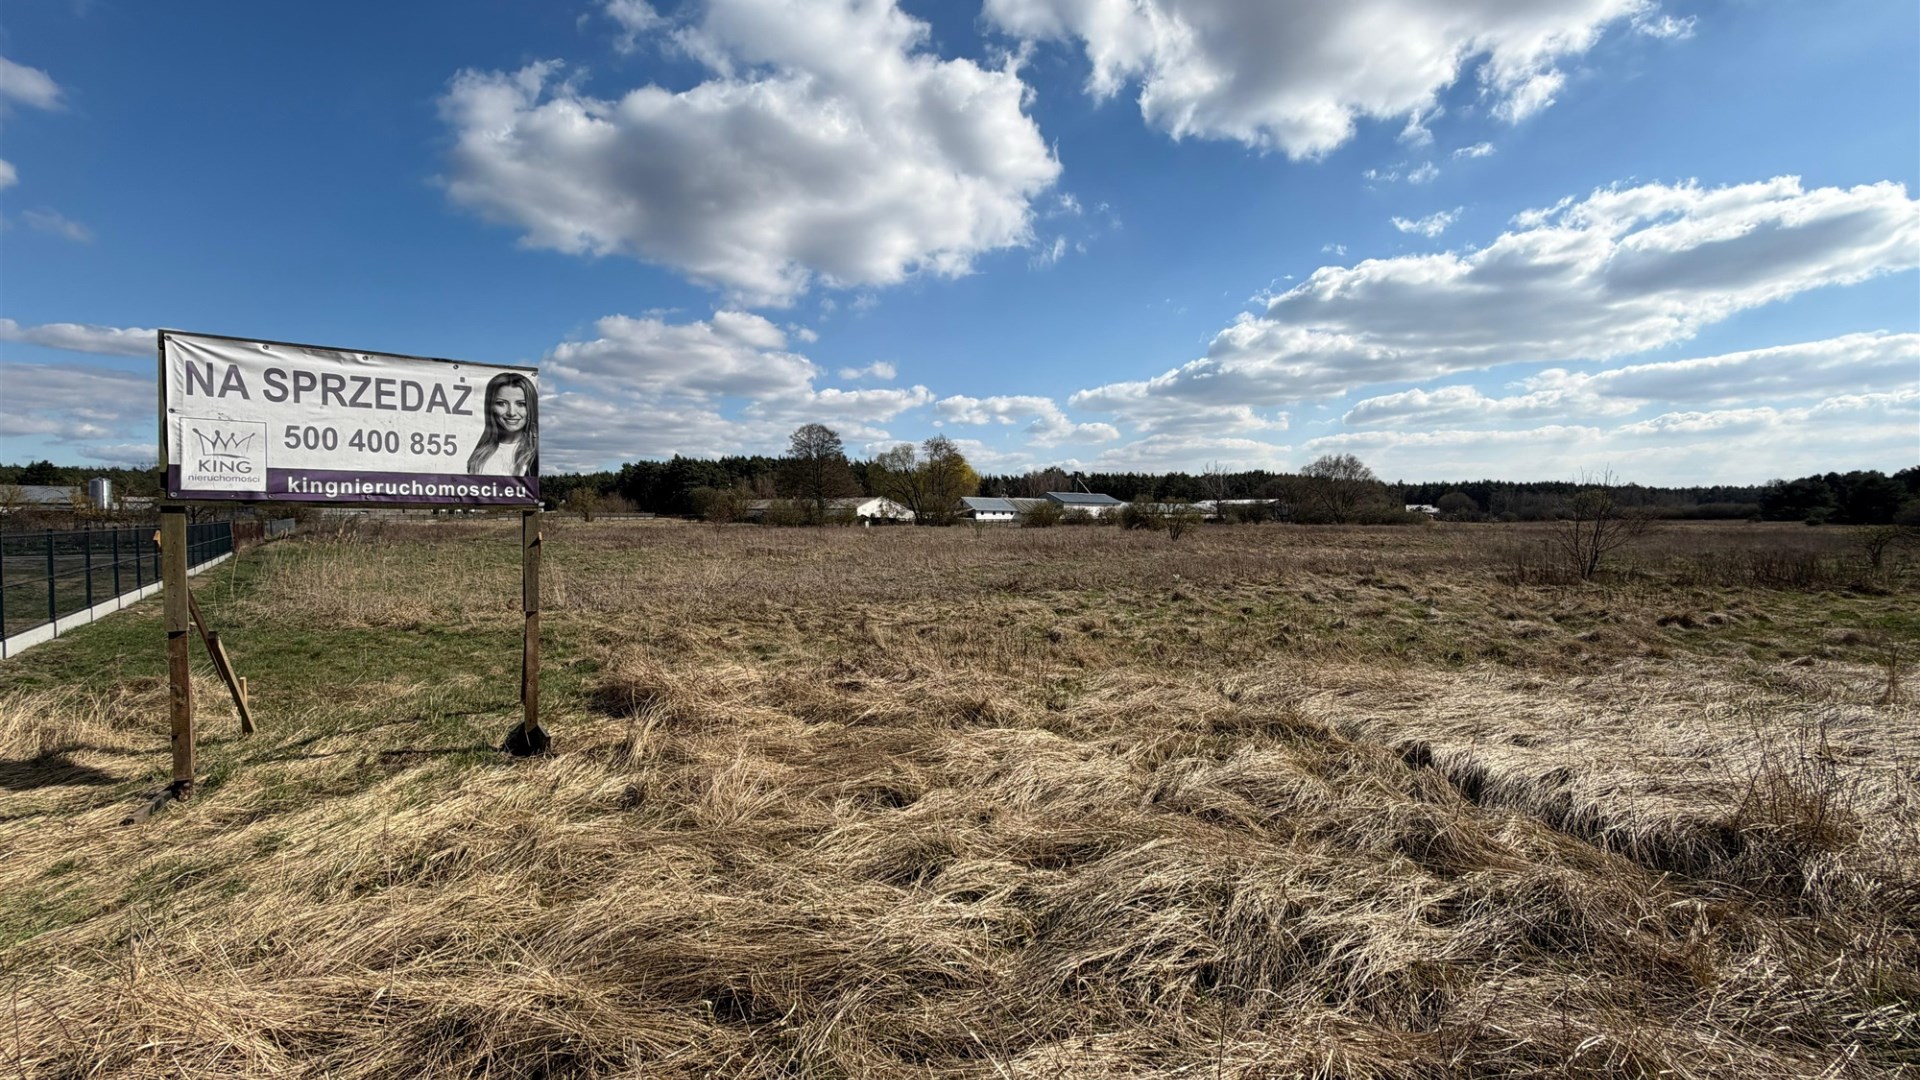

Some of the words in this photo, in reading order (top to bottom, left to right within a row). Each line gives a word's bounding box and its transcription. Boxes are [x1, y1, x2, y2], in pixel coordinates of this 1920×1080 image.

[184, 360, 249, 399] NA
[262, 367, 473, 416] SPRZEDAŻ
[284, 425, 338, 451] 500
[348, 429, 399, 454] 400
[410, 432, 458, 456] 855
[198, 459, 252, 474] KING
[287, 476, 526, 499] kingnieruchomosci.eu
